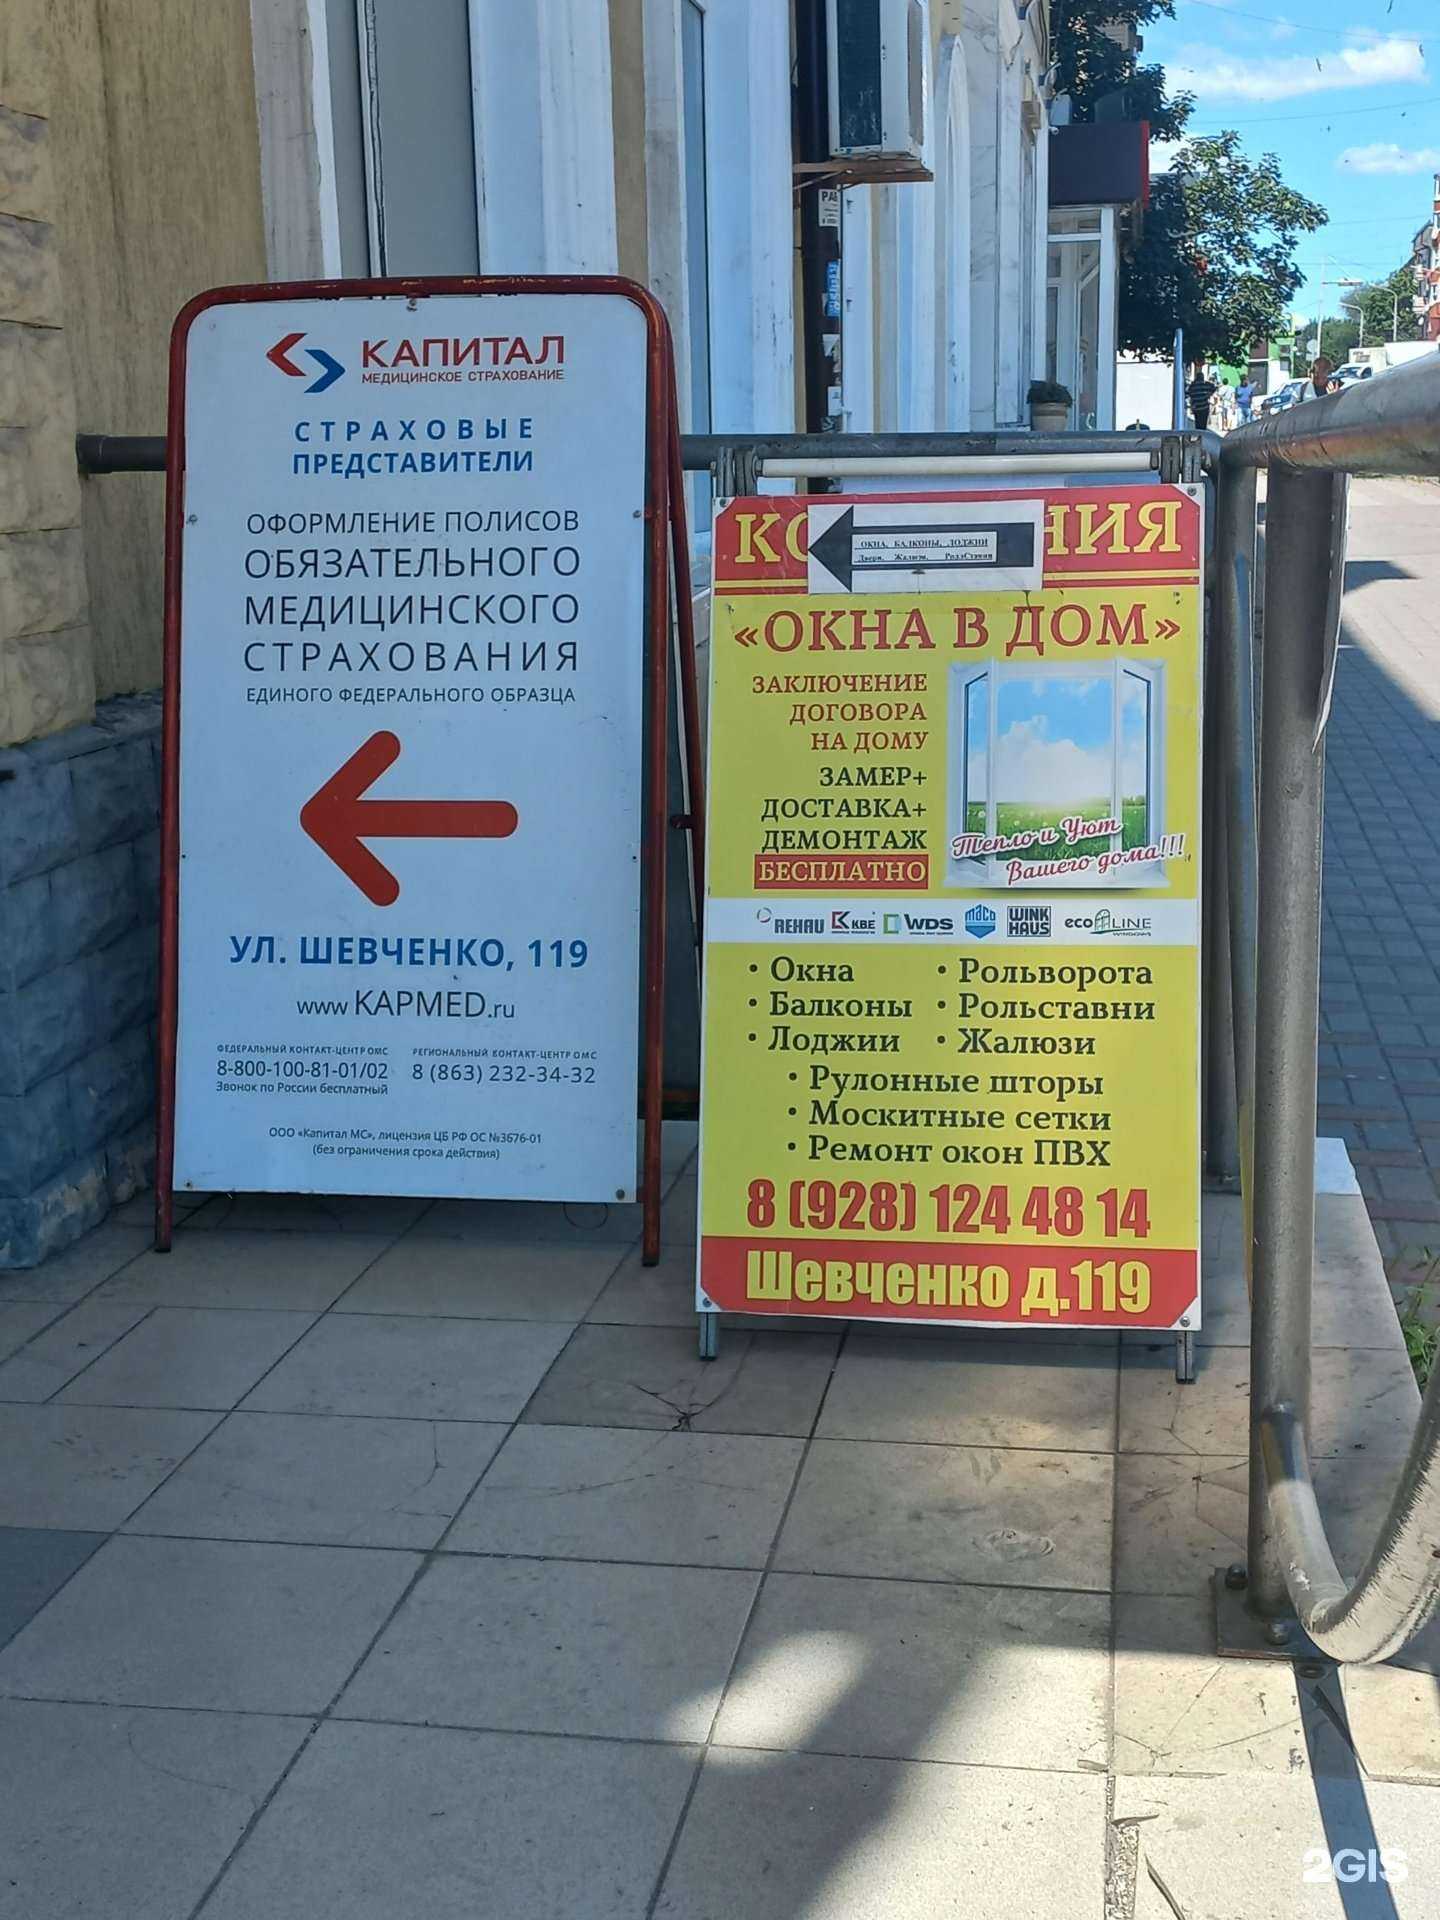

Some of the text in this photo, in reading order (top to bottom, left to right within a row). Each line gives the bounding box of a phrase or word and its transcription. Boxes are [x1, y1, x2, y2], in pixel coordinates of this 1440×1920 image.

[362, 335, 565, 369] КАПИТАЛ
[361, 369, 565, 386] МЕДИЦИНСКОЕ СТРАХОВАНИЕ
[294, 418, 533, 443] СТРАХОВЫЕ
[293, 450, 533, 479] ПРЕДСТАВИТЕЛИ
[247, 511, 580, 535] ОФОРМЛЕНИЕ ПОЛИСОВ
[244, 546, 581, 579] ОБЯЗАТЕЛЬНОГО
[245, 594, 580, 632] МЕДИЦИНСКОГО
[734, 603, 1181, 657] «ОКНА В ДОМ»
[244, 641, 578, 673] СТРАХОВАНИЯ
[247, 687, 576, 705] ЕДИНОГО ФЕДЕРАЛЬНОГО ОБРАЗЦА
[752, 674, 928, 696] ЗАКЛЮЧЕНИЕ
[789, 703, 928, 727] ДОГОВОРА
[810, 731, 929, 755] НА ДОМУ
[819, 767, 928, 787] ЗАМЕР+
[761, 799, 928, 824] ДОСТАВКА+
[761, 830, 928, 855] ДЕМОНТАЖ
[952, 816, 1121, 857] Тепло и Уют
[758, 859, 927, 885] БЕСПЛАТНО
[1006, 835, 1185, 886] Вашего дома!!!
[774, 918, 825, 934] REHAU
[851, 919, 876, 930] KBE
[904, 914, 954, 930] WDS
[1009, 908, 1049, 921] WINK
[1009, 922, 1049, 935] HAUS
[229, 936, 588, 971] УЛ. ШЕВЧЕНКО, 119
[770, 956, 854, 983] Окна
[958, 958, 1153, 991] Рольворота
[297, 990, 515, 1019] www KAPMED.ru
[769, 991, 913, 1018] Балконы
[958, 993, 1156, 1021] Рольставни
[217, 1044, 388, 1056] ФЕДЕРАЛЬНЫЙ КОНТАКТ-ЦЕНТР ОМС
[768, 1026, 901, 1055] Лоджии
[958, 1028, 1096, 1055] Жалюзи
[412, 1047, 598, 1060] РЕГИОНАЛЬНЫЙ КОНТАКТ-ЦЕНТР ОМС
[217, 1060, 388, 1079] 8-800-100-81-01/02
[412, 1064, 596, 1084] 8 (863) 232-34-32
[216, 1081, 388, 1096] Звонок по России бесплатный
[809, 1066, 1104, 1102] Рулонные шторы
[809, 1101, 1111, 1131] Москитные сетки
[269, 1127, 295, 1138] ООО
[298, 1128, 347, 1140] «Капитал
[378, 1131, 431, 1143] лицензия
[433, 1131, 449, 1143] ЦБ
[451, 1131, 468, 1143] РФ
[470, 1132, 487, 1143] ОС
[312, 1144, 500, 1161] (без ограничения срока действия)
[809, 1136, 1111, 1167] Ремонт окон ПВХ
[747, 1179, 1152, 1238] 8 (928) 124 48 14
[746, 1250, 1152, 1317] Шевченко д.119
